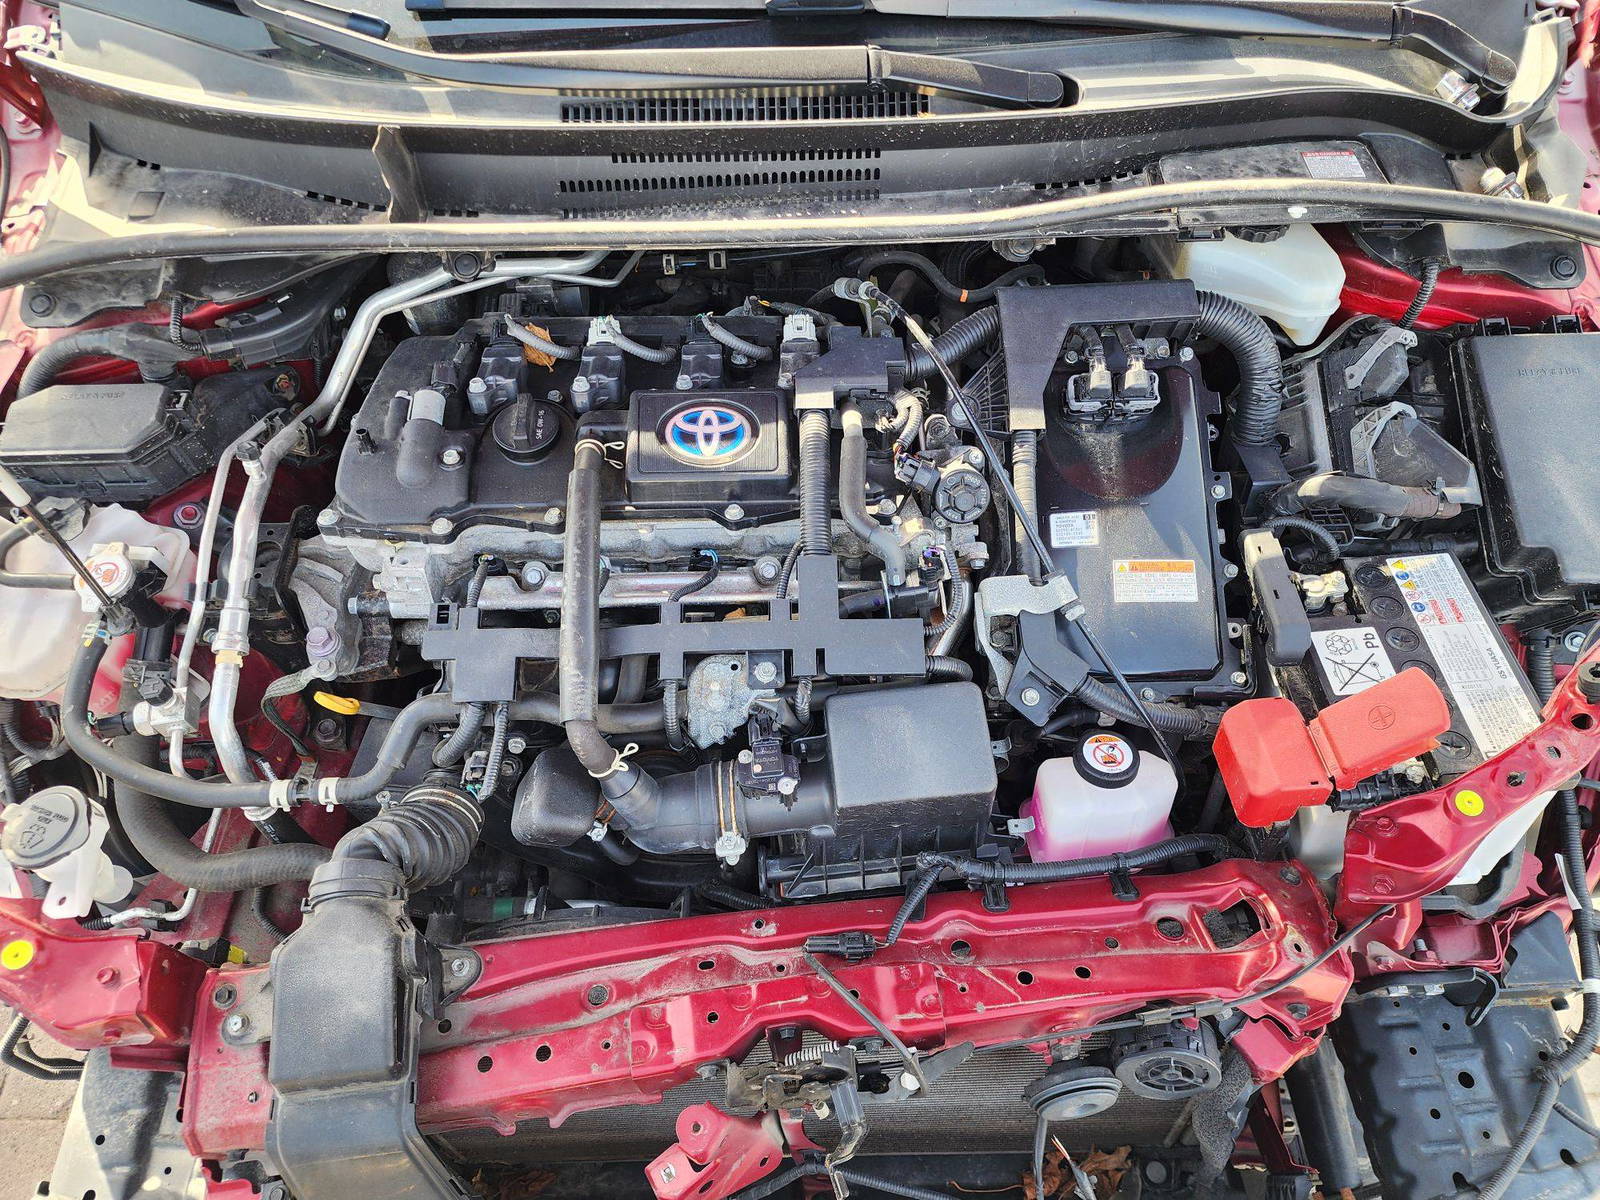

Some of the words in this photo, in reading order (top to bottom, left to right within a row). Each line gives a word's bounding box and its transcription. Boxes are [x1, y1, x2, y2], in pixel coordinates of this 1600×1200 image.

[537, 409, 546, 429] 0W-16
[535, 429, 543, 440] SAE
[1363, 632, 1379, 650] Pb
[1486, 647, 1500, 670] YUASA
[1498, 669, 1508, 680] GS
